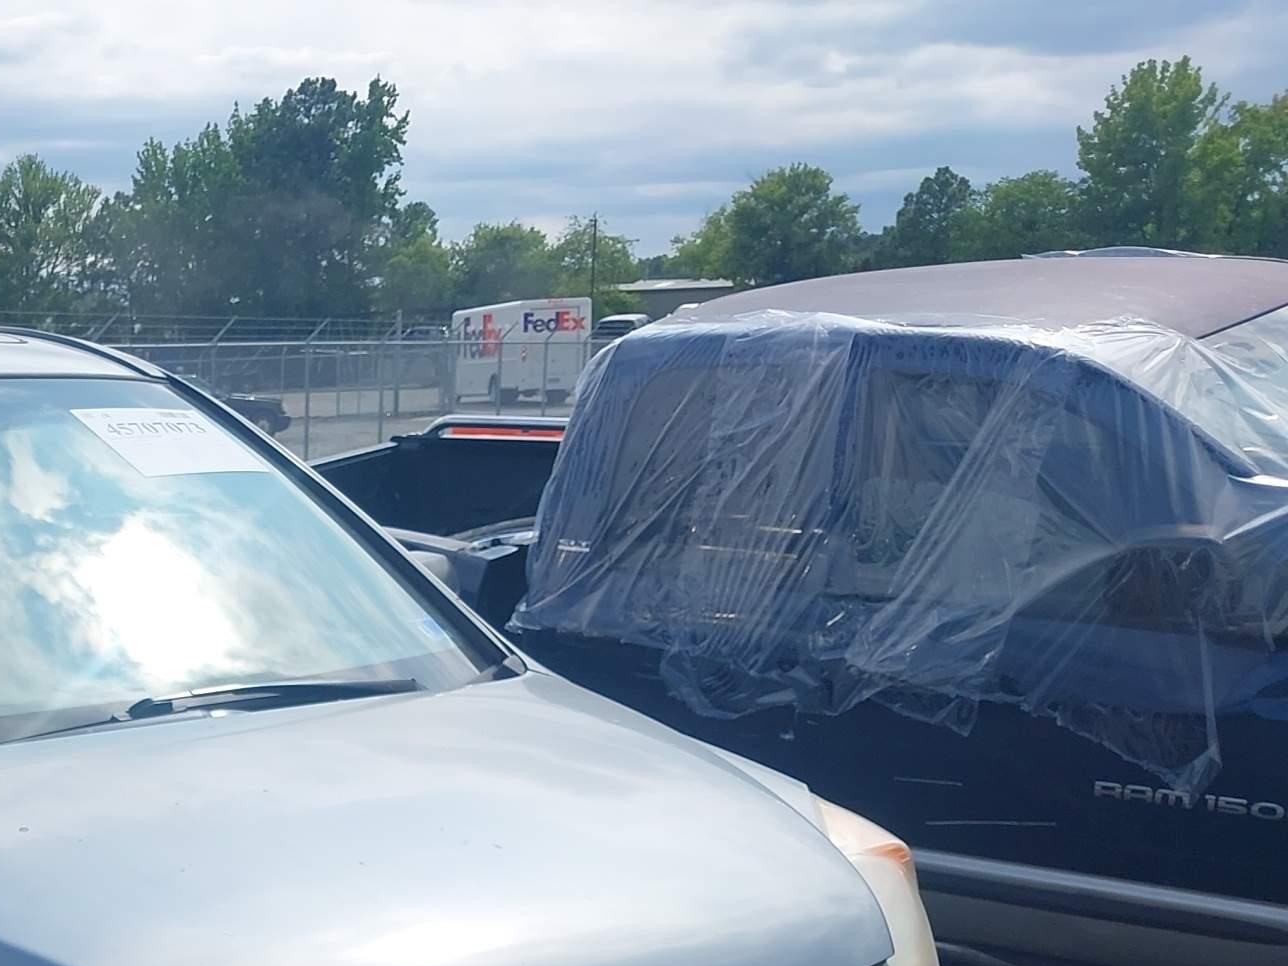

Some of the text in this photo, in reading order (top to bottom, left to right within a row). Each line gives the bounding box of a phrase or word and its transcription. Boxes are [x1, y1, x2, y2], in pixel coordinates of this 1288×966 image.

[523, 311, 585, 334] FedEx
[106, 421, 207, 437] 45707073
[1093, 780, 1193, 810] RAM
